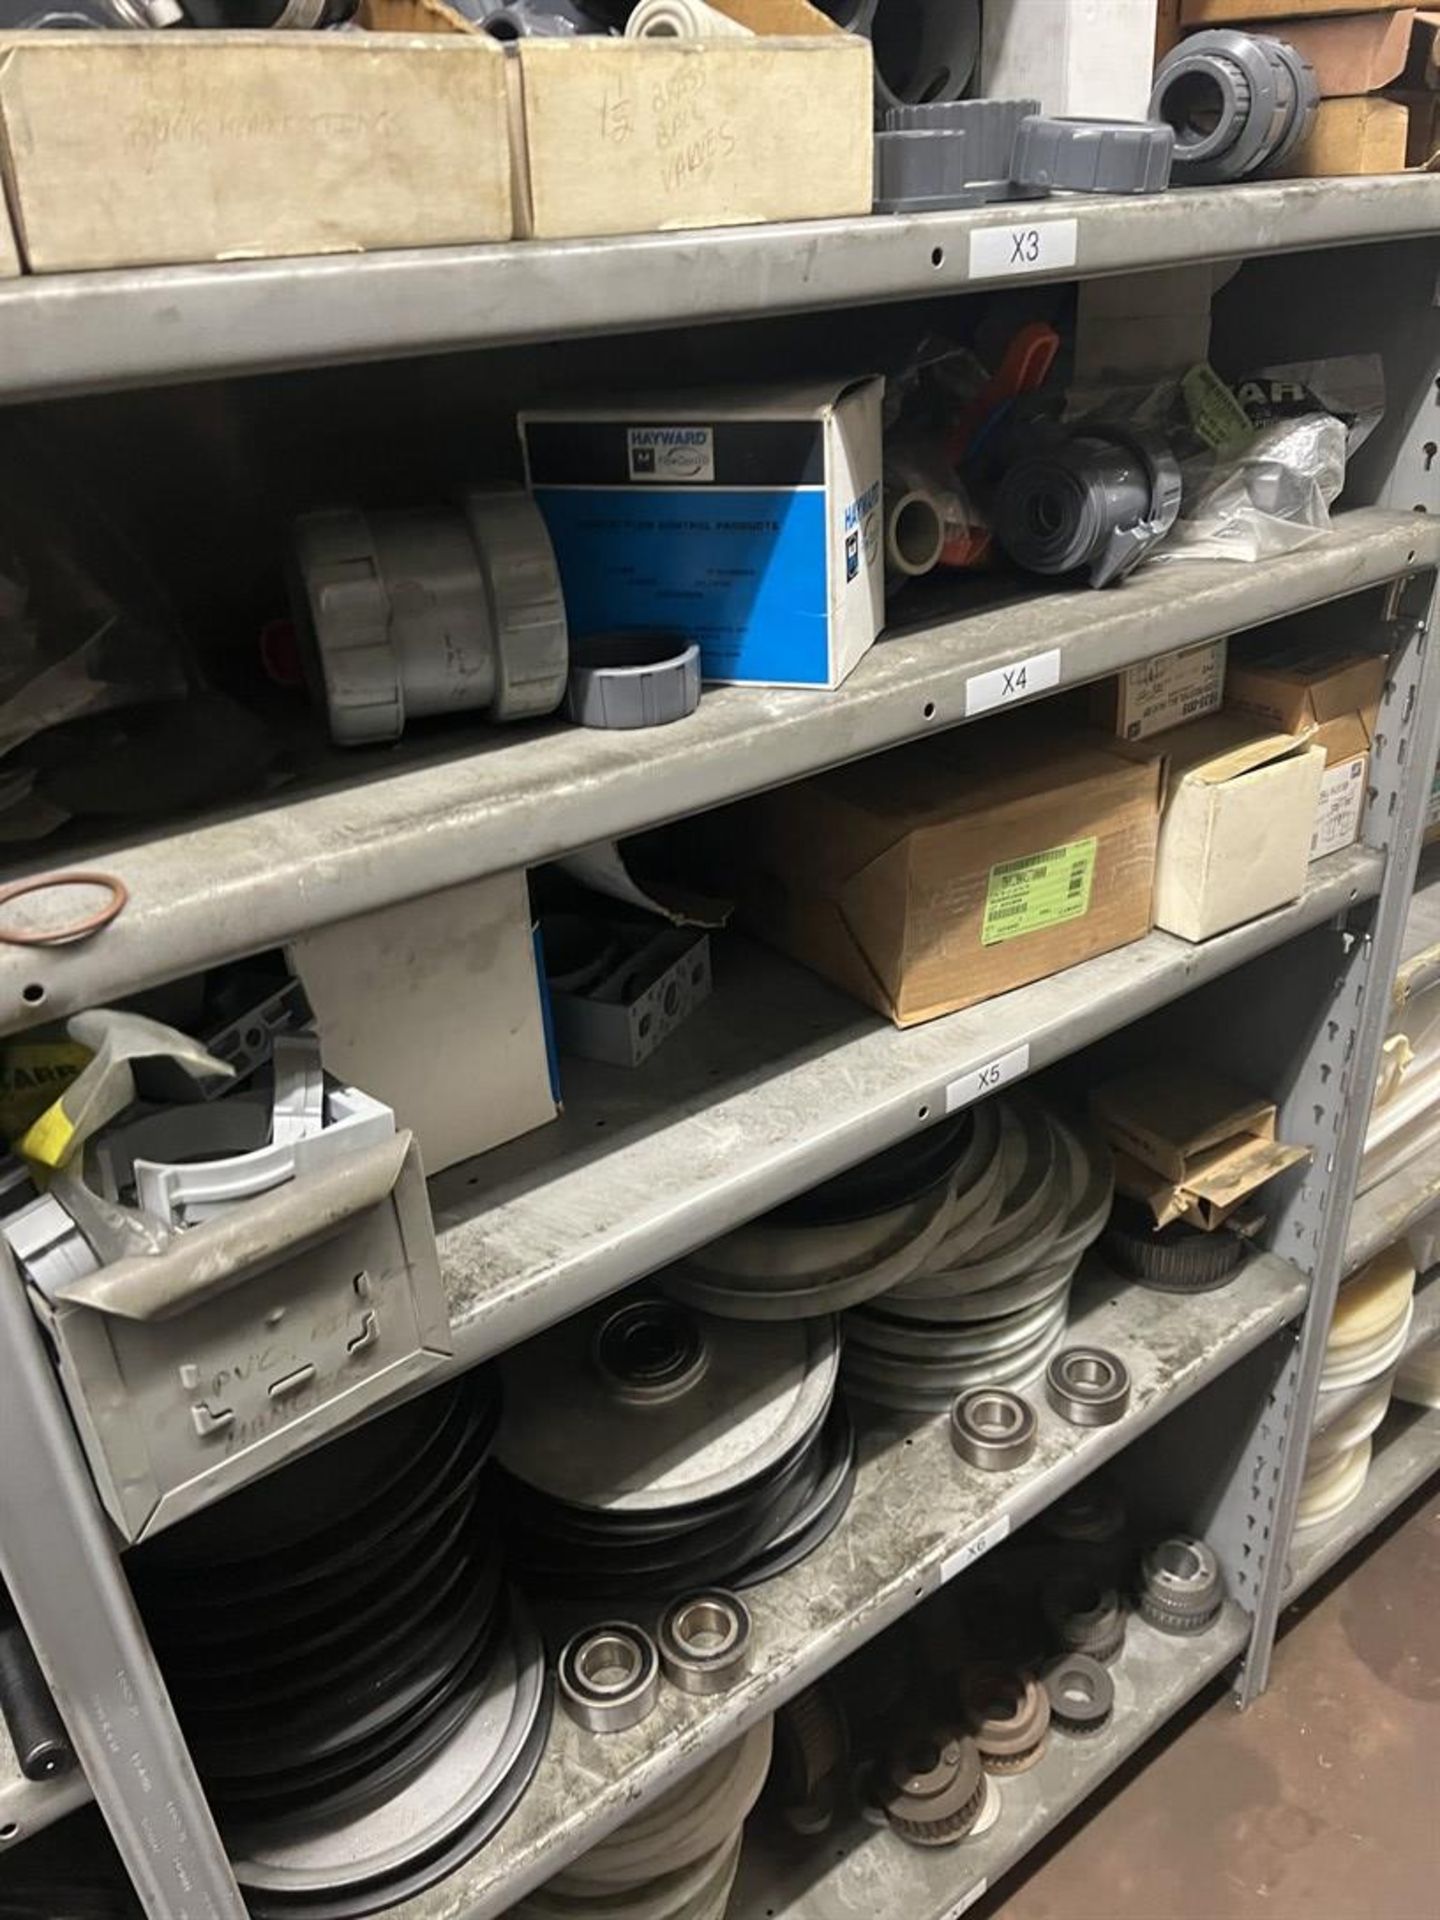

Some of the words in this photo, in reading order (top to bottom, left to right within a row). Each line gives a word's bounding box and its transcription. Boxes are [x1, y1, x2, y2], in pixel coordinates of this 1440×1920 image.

[1010, 229, 1039, 263] X3
[632, 430, 707, 446] HAYWARD
[1002, 665, 1027, 696] X4
[978, 1063, 1000, 1090] X5
[966, 1534, 987, 1561] X6
